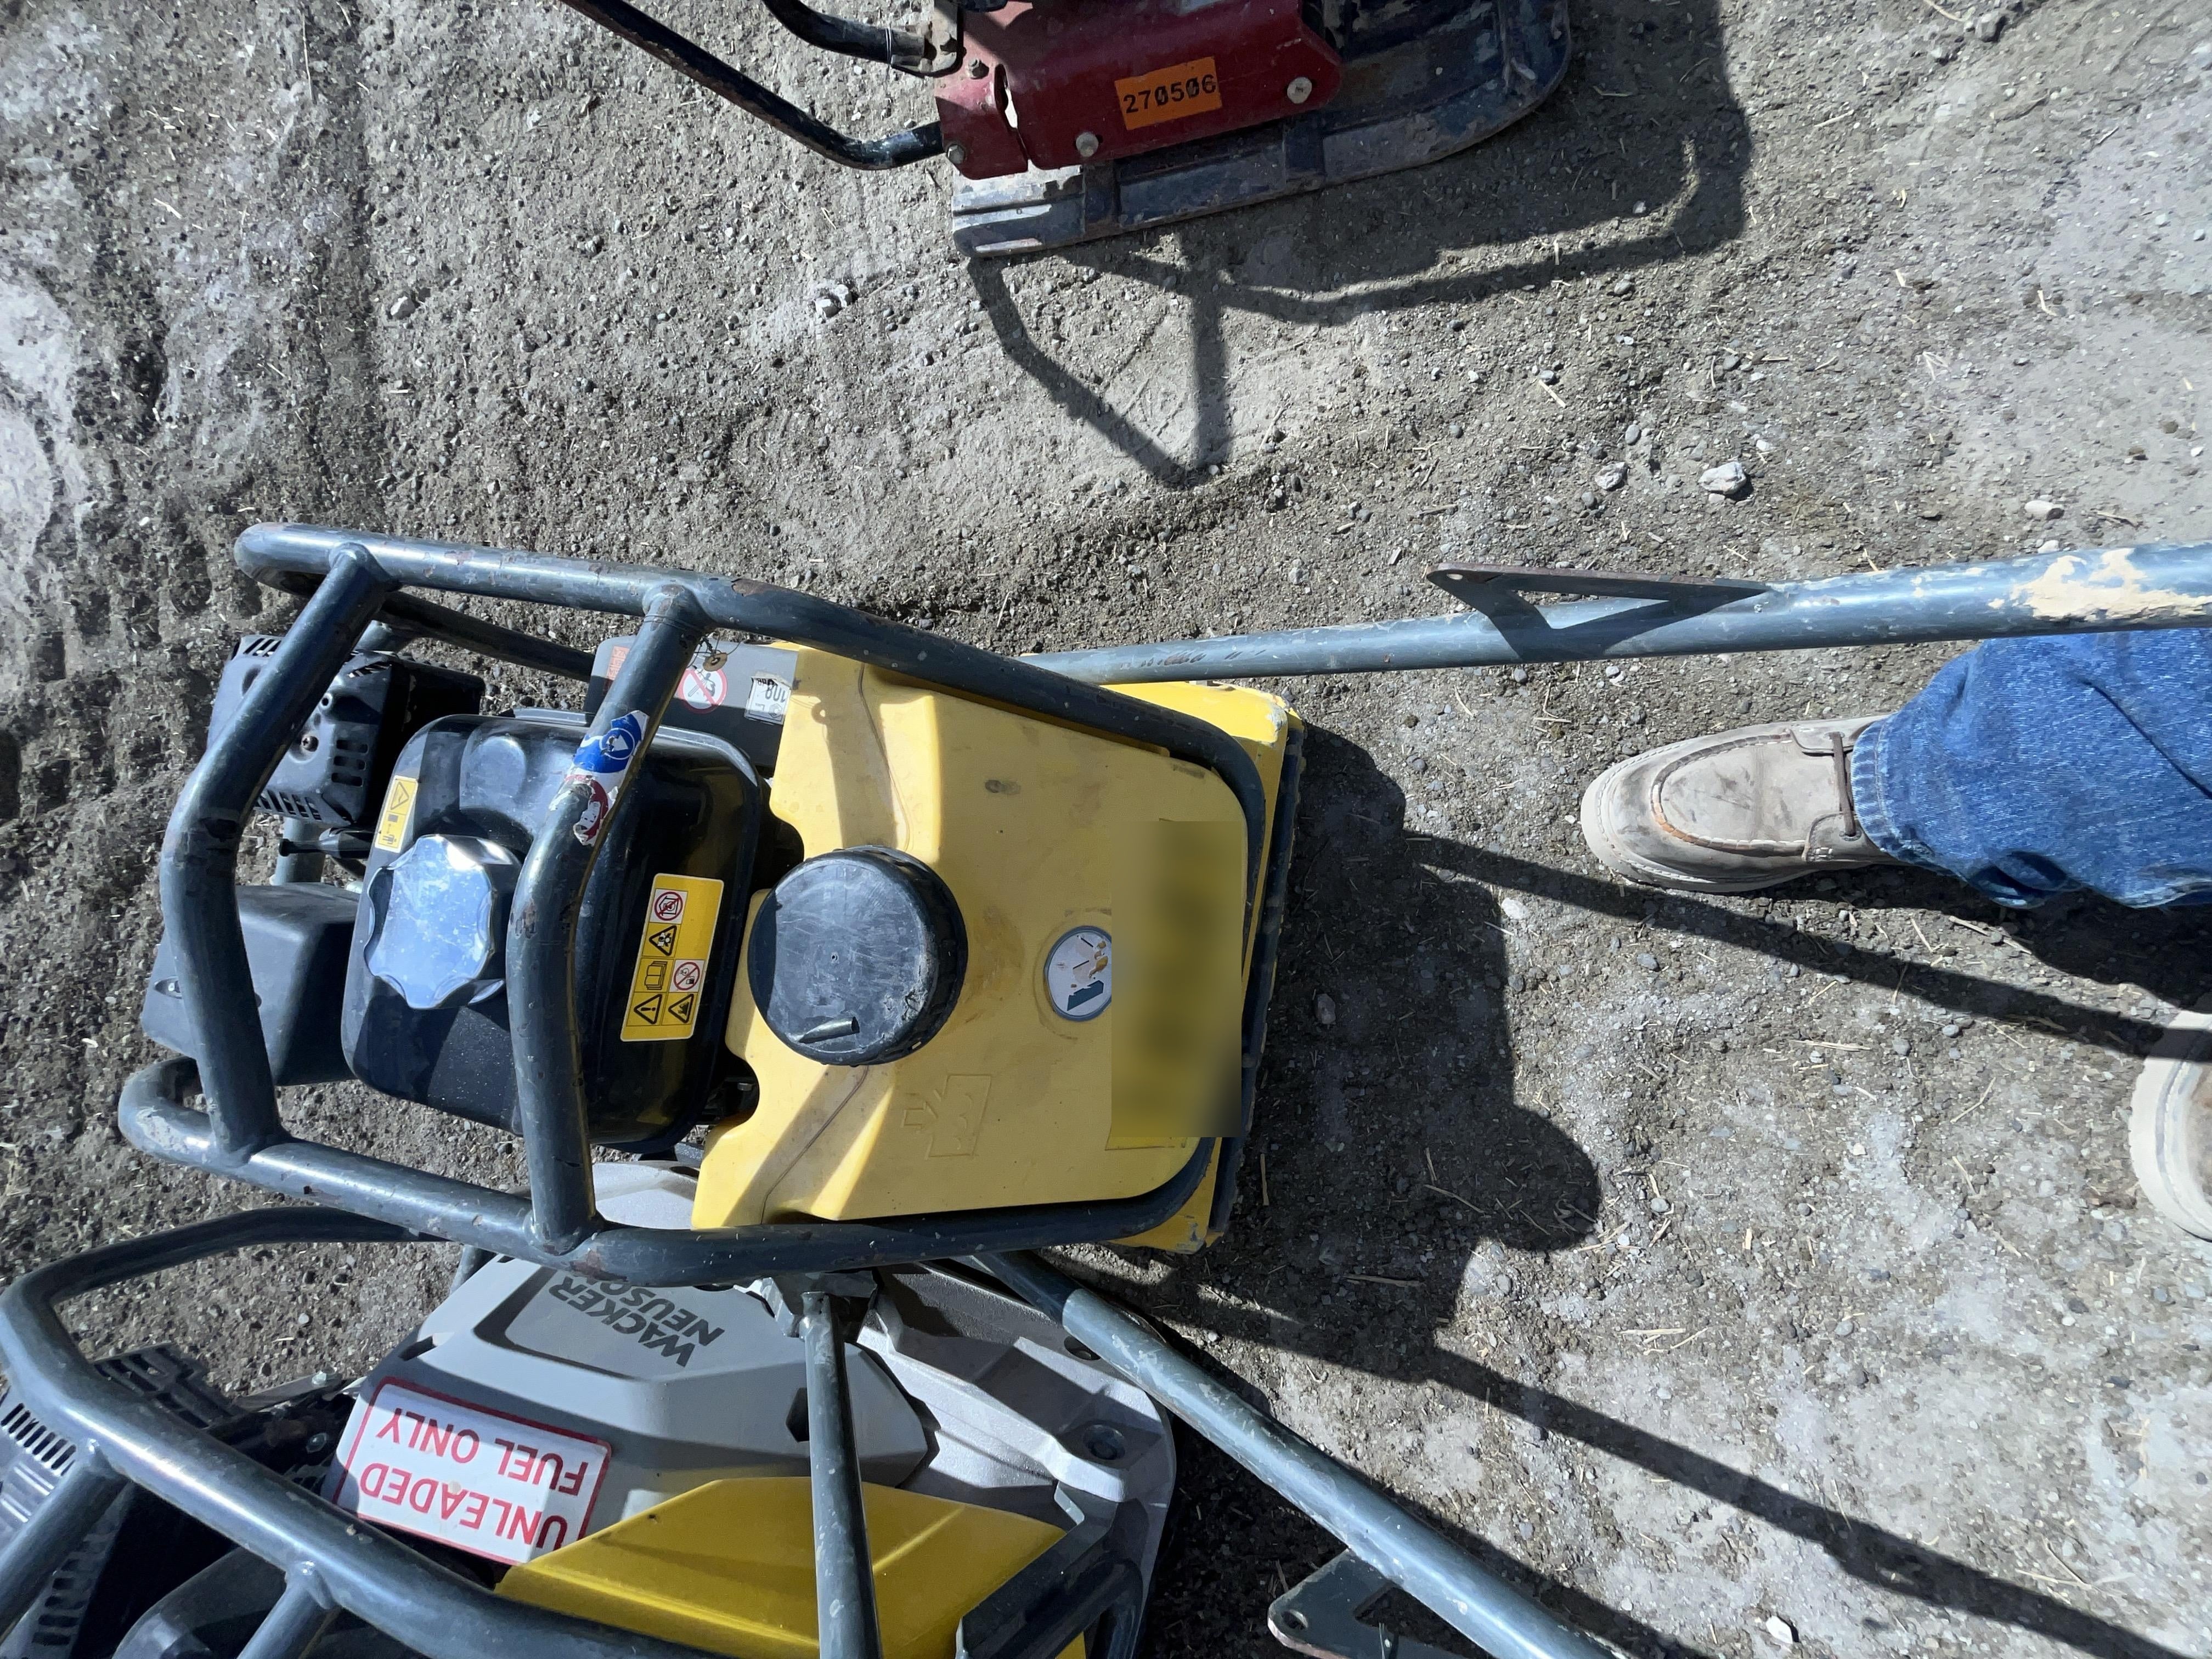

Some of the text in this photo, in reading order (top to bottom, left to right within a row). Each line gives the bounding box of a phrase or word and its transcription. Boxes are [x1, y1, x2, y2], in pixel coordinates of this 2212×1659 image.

[1123, 73, 1216, 114] 270506
[549, 1276, 696, 1368] WACKER
[375, 1408, 589, 1496] FUEL ONLY
[360, 1462, 568, 1551] UNLEADED
